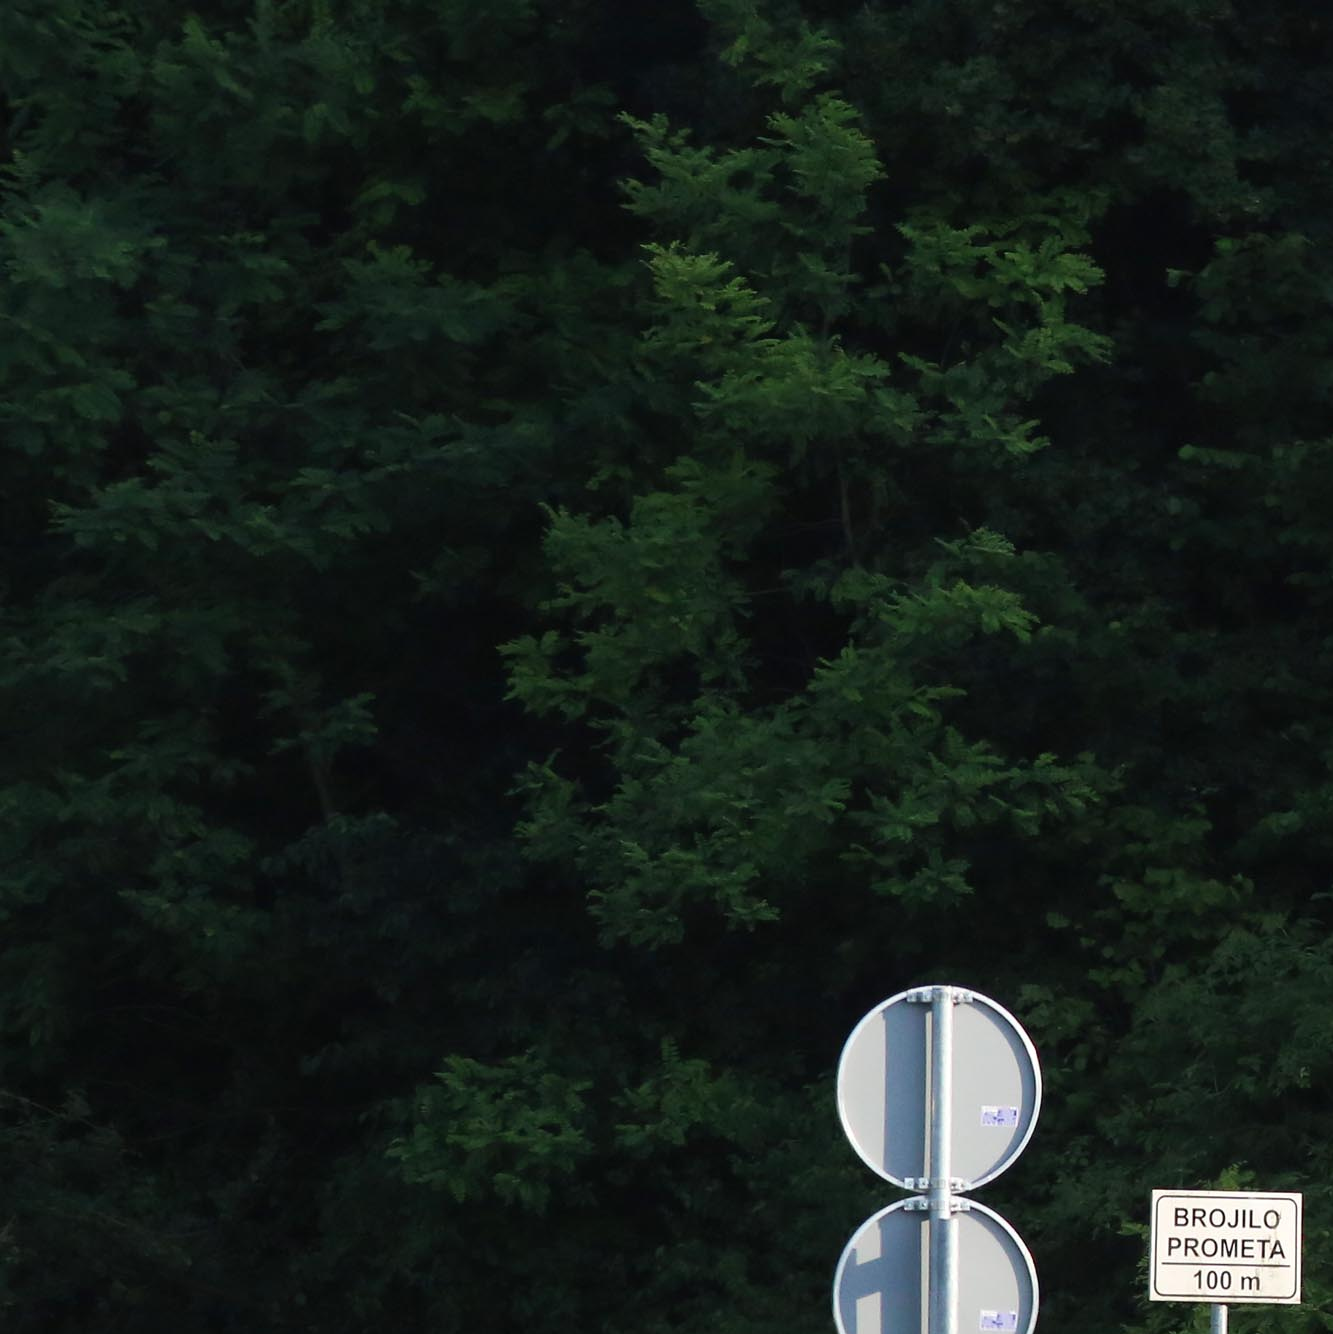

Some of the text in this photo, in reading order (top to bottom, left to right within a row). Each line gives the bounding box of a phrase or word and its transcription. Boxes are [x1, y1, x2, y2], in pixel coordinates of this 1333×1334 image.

[1174, 1207, 1280, 1229] BROJILO
[1168, 1237, 1286, 1259] PROMETA
[1194, 1270, 1260, 1291] 100 m
